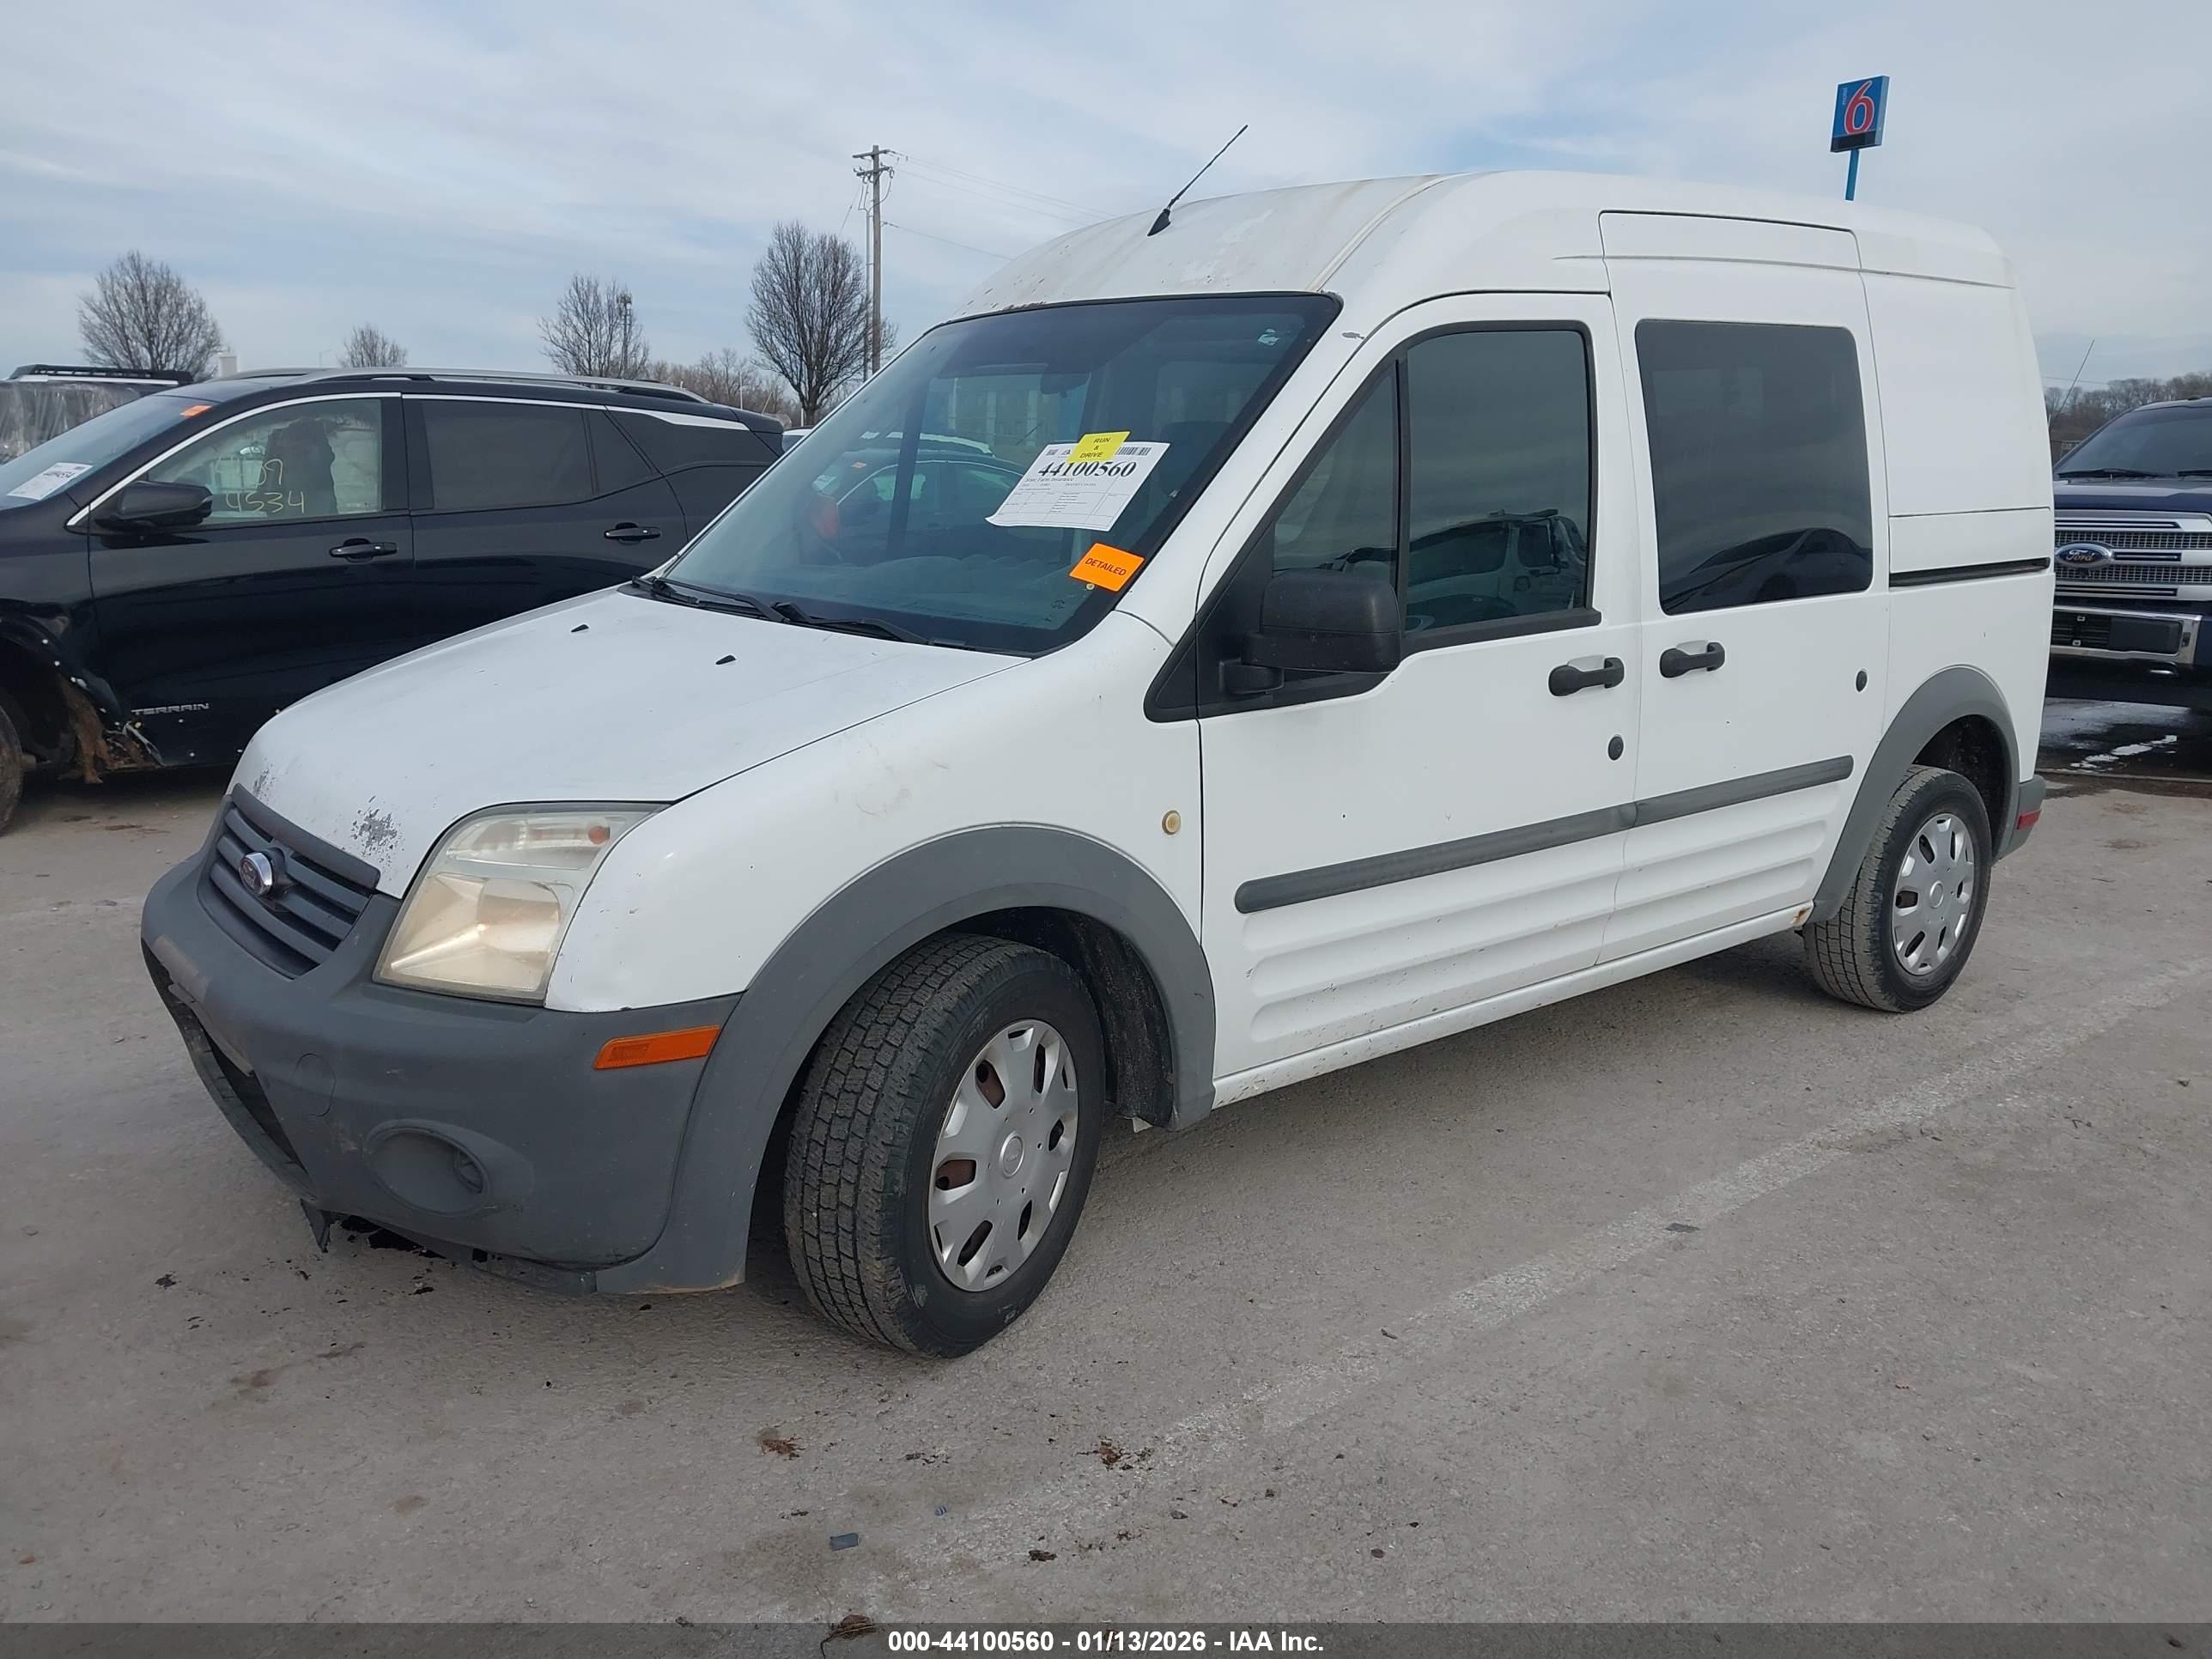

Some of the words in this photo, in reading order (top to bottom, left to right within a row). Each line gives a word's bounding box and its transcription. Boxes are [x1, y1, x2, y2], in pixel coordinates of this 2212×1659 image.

[1844, 80, 1875, 136] 6
[1037, 460, 1138, 477] 44100560
[225, 489, 305, 514] 4534
[2065, 549, 2096, 562] Ford
[1085, 557, 1127, 576] DETAILED
[131, 702, 210, 715] TERRAIN
